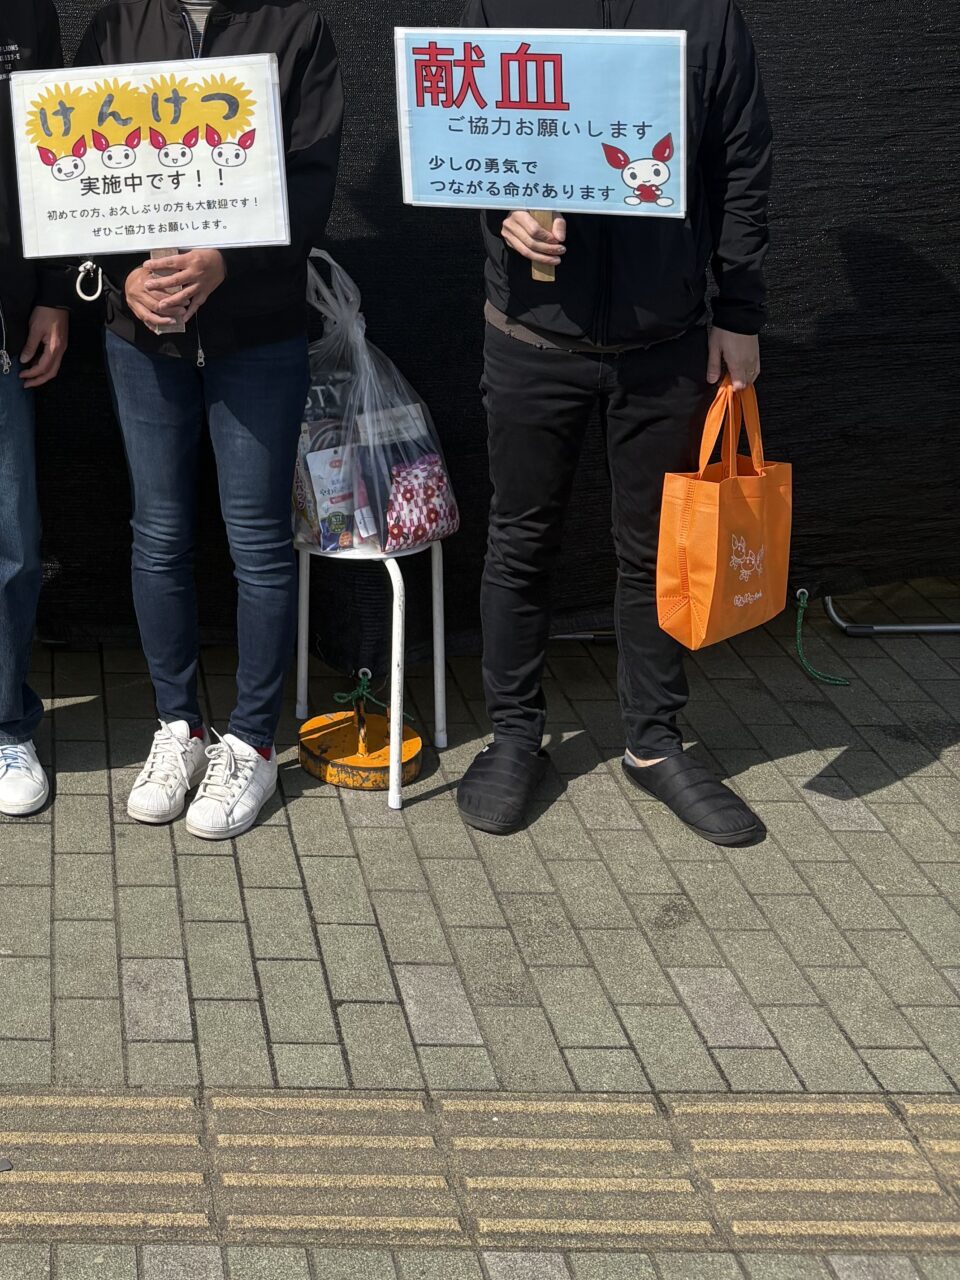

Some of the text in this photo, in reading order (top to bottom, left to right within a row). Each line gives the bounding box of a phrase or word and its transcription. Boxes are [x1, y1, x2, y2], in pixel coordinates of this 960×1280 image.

[411, 40, 570, 111] 献血
[39, 88, 240, 138] けんけつ
[447, 115, 653, 140] ご協力お願いします
[428, 155, 538, 175] 少しの勇気で
[430, 179, 615, 202] つながる命があります
[92, 218, 229, 238] ぜひご協力をお願いします。
